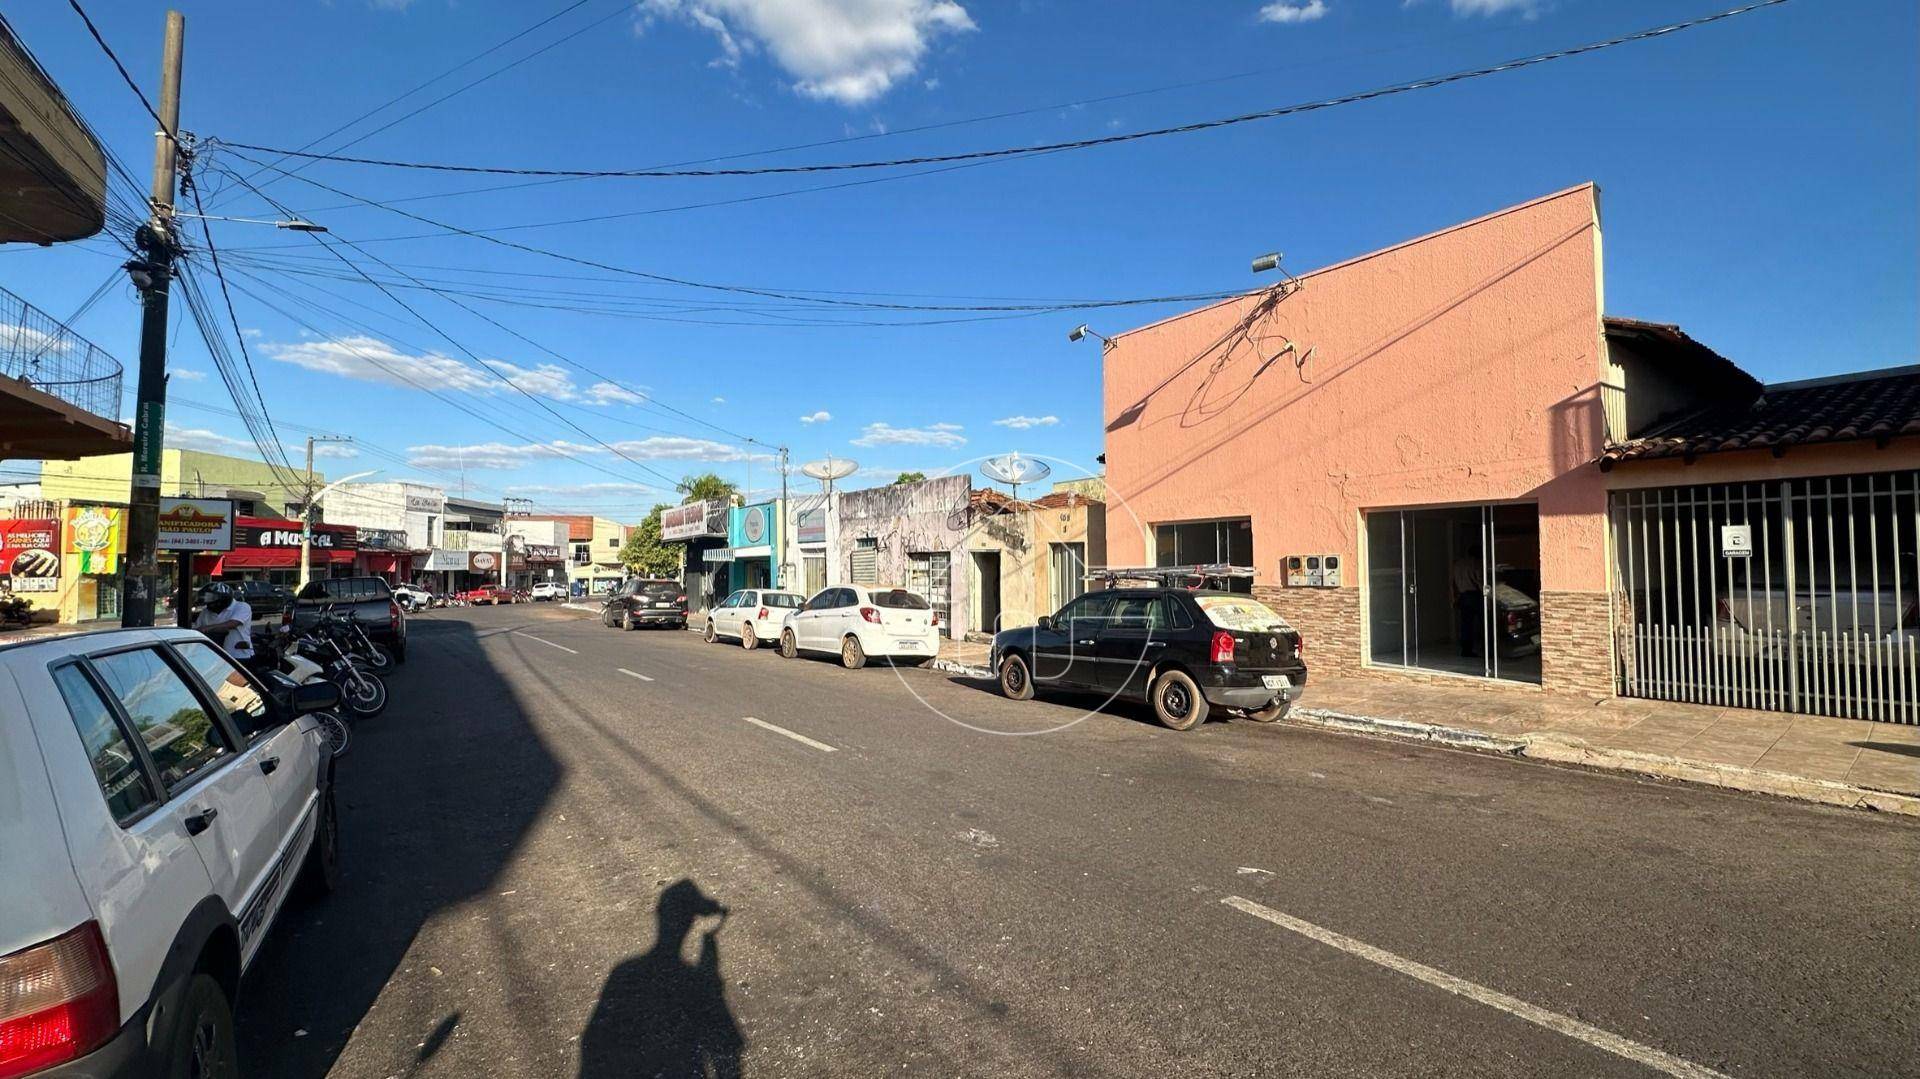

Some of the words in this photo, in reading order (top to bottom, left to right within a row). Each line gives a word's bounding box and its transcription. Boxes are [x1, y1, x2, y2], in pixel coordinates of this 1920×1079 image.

[141, 402, 149, 429] Cabral
[141, 430, 149, 462] Moreira
[159, 520, 220, 528] ANIFICADORA
[274, 530, 333, 547] MUSCAL
